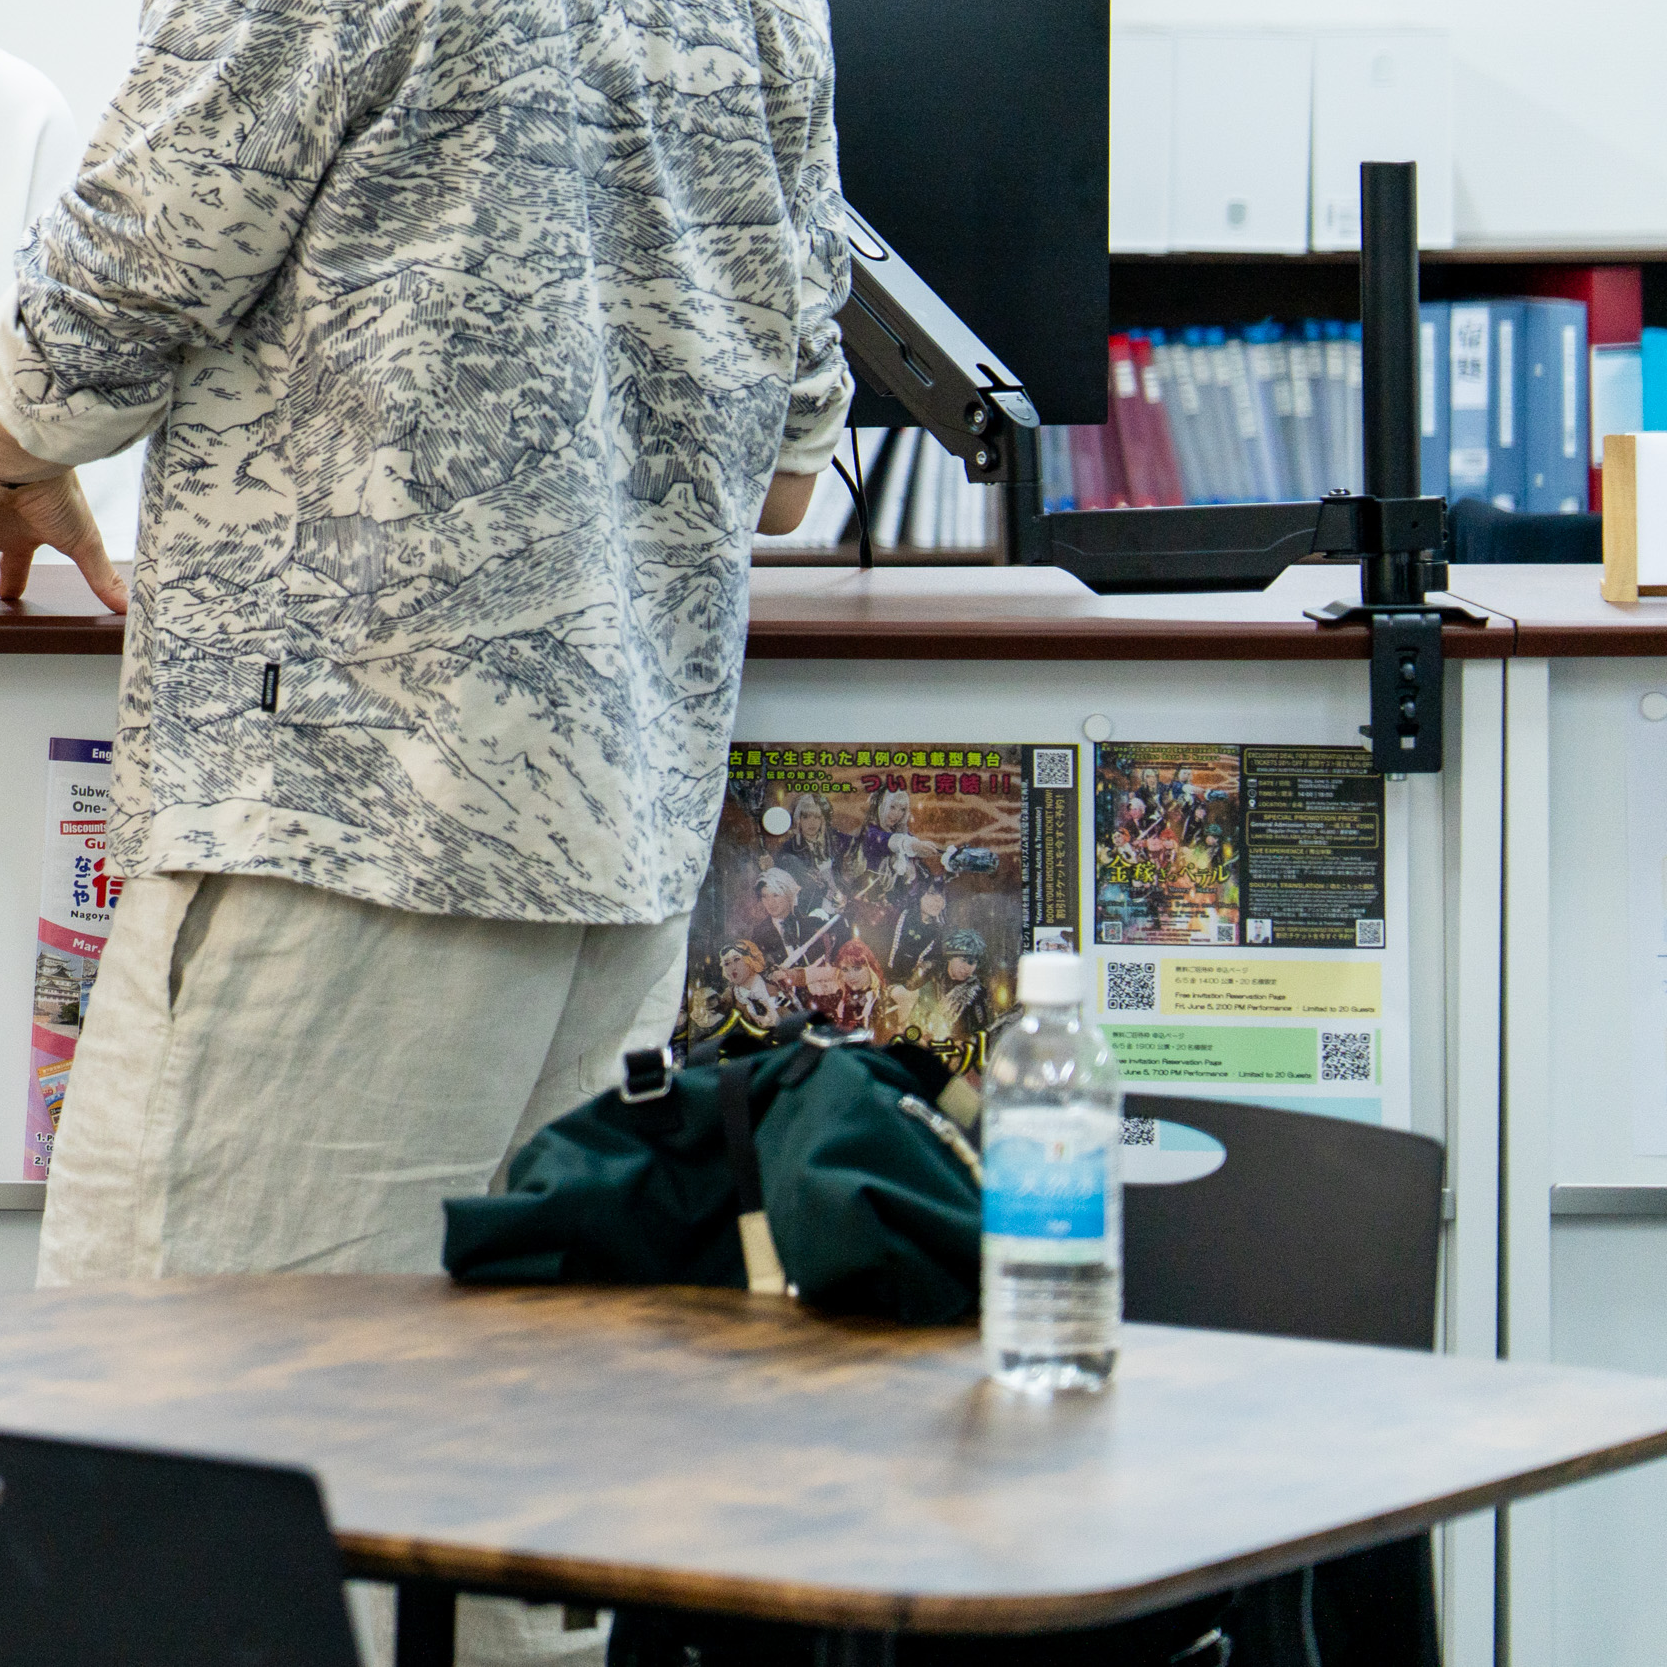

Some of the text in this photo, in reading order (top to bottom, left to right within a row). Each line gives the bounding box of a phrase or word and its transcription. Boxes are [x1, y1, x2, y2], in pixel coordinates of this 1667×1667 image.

[92, 748, 113, 762] Eng
[729, 750, 1001, 768] 古屋で生まれた異例の連載型舞台
[73, 801, 107, 814] One-
[85, 838, 107, 850] Gu
[1045, 790, 1054, 924] BOOK YOUR DISCOUNTED TICKET NOW!
[73, 856, 92, 907] なごや
[71, 910, 110, 921] Nagoya
[73, 938, 102, 954] Mar.
